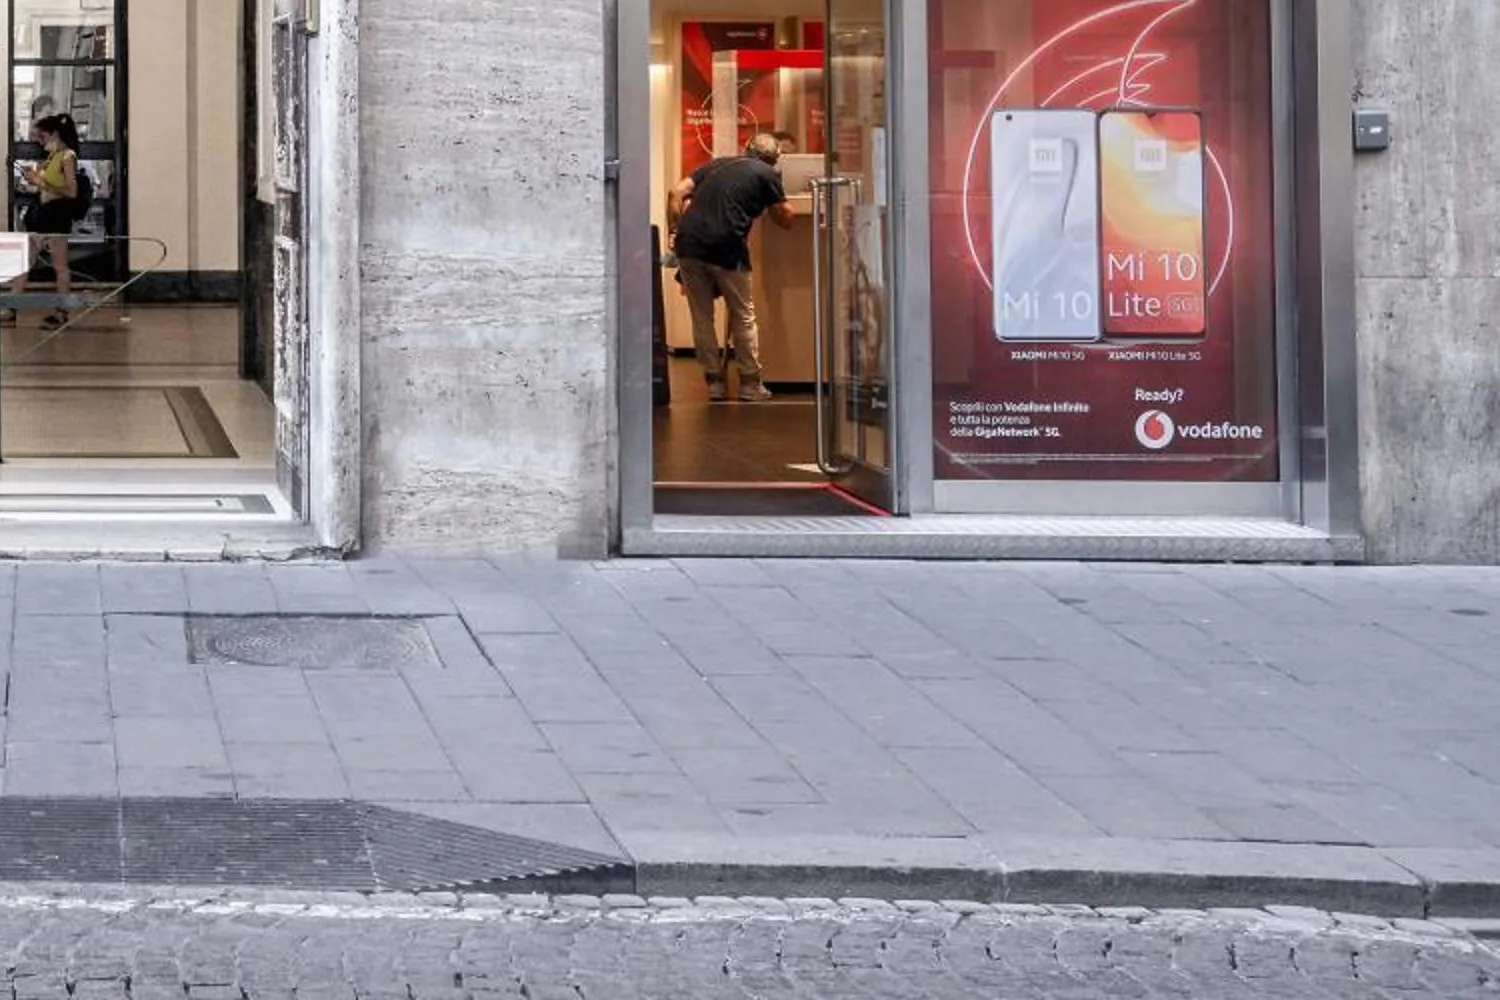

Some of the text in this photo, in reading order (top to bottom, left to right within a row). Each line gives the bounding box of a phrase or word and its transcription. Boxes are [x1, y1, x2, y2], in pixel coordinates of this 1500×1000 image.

[1108, 252, 1198, 281] Mi 10
[1002, 290, 1092, 320] Mi 10
[1108, 292, 1161, 317] Lite
[1011, 351, 1047, 361] XIAOMI
[1108, 351, 1144, 361] XIAOMI
[1135, 388, 1183, 404] Ready?
[985, 403, 1003, 412] con
[1003, 401, 1052, 412] Vodafone
[957, 415, 981, 425] tutta
[981, 415, 990, 425] la
[991, 415, 1031, 426] potenza
[950, 427, 973, 437] della
[1178, 421, 1263, 439] vodafone
